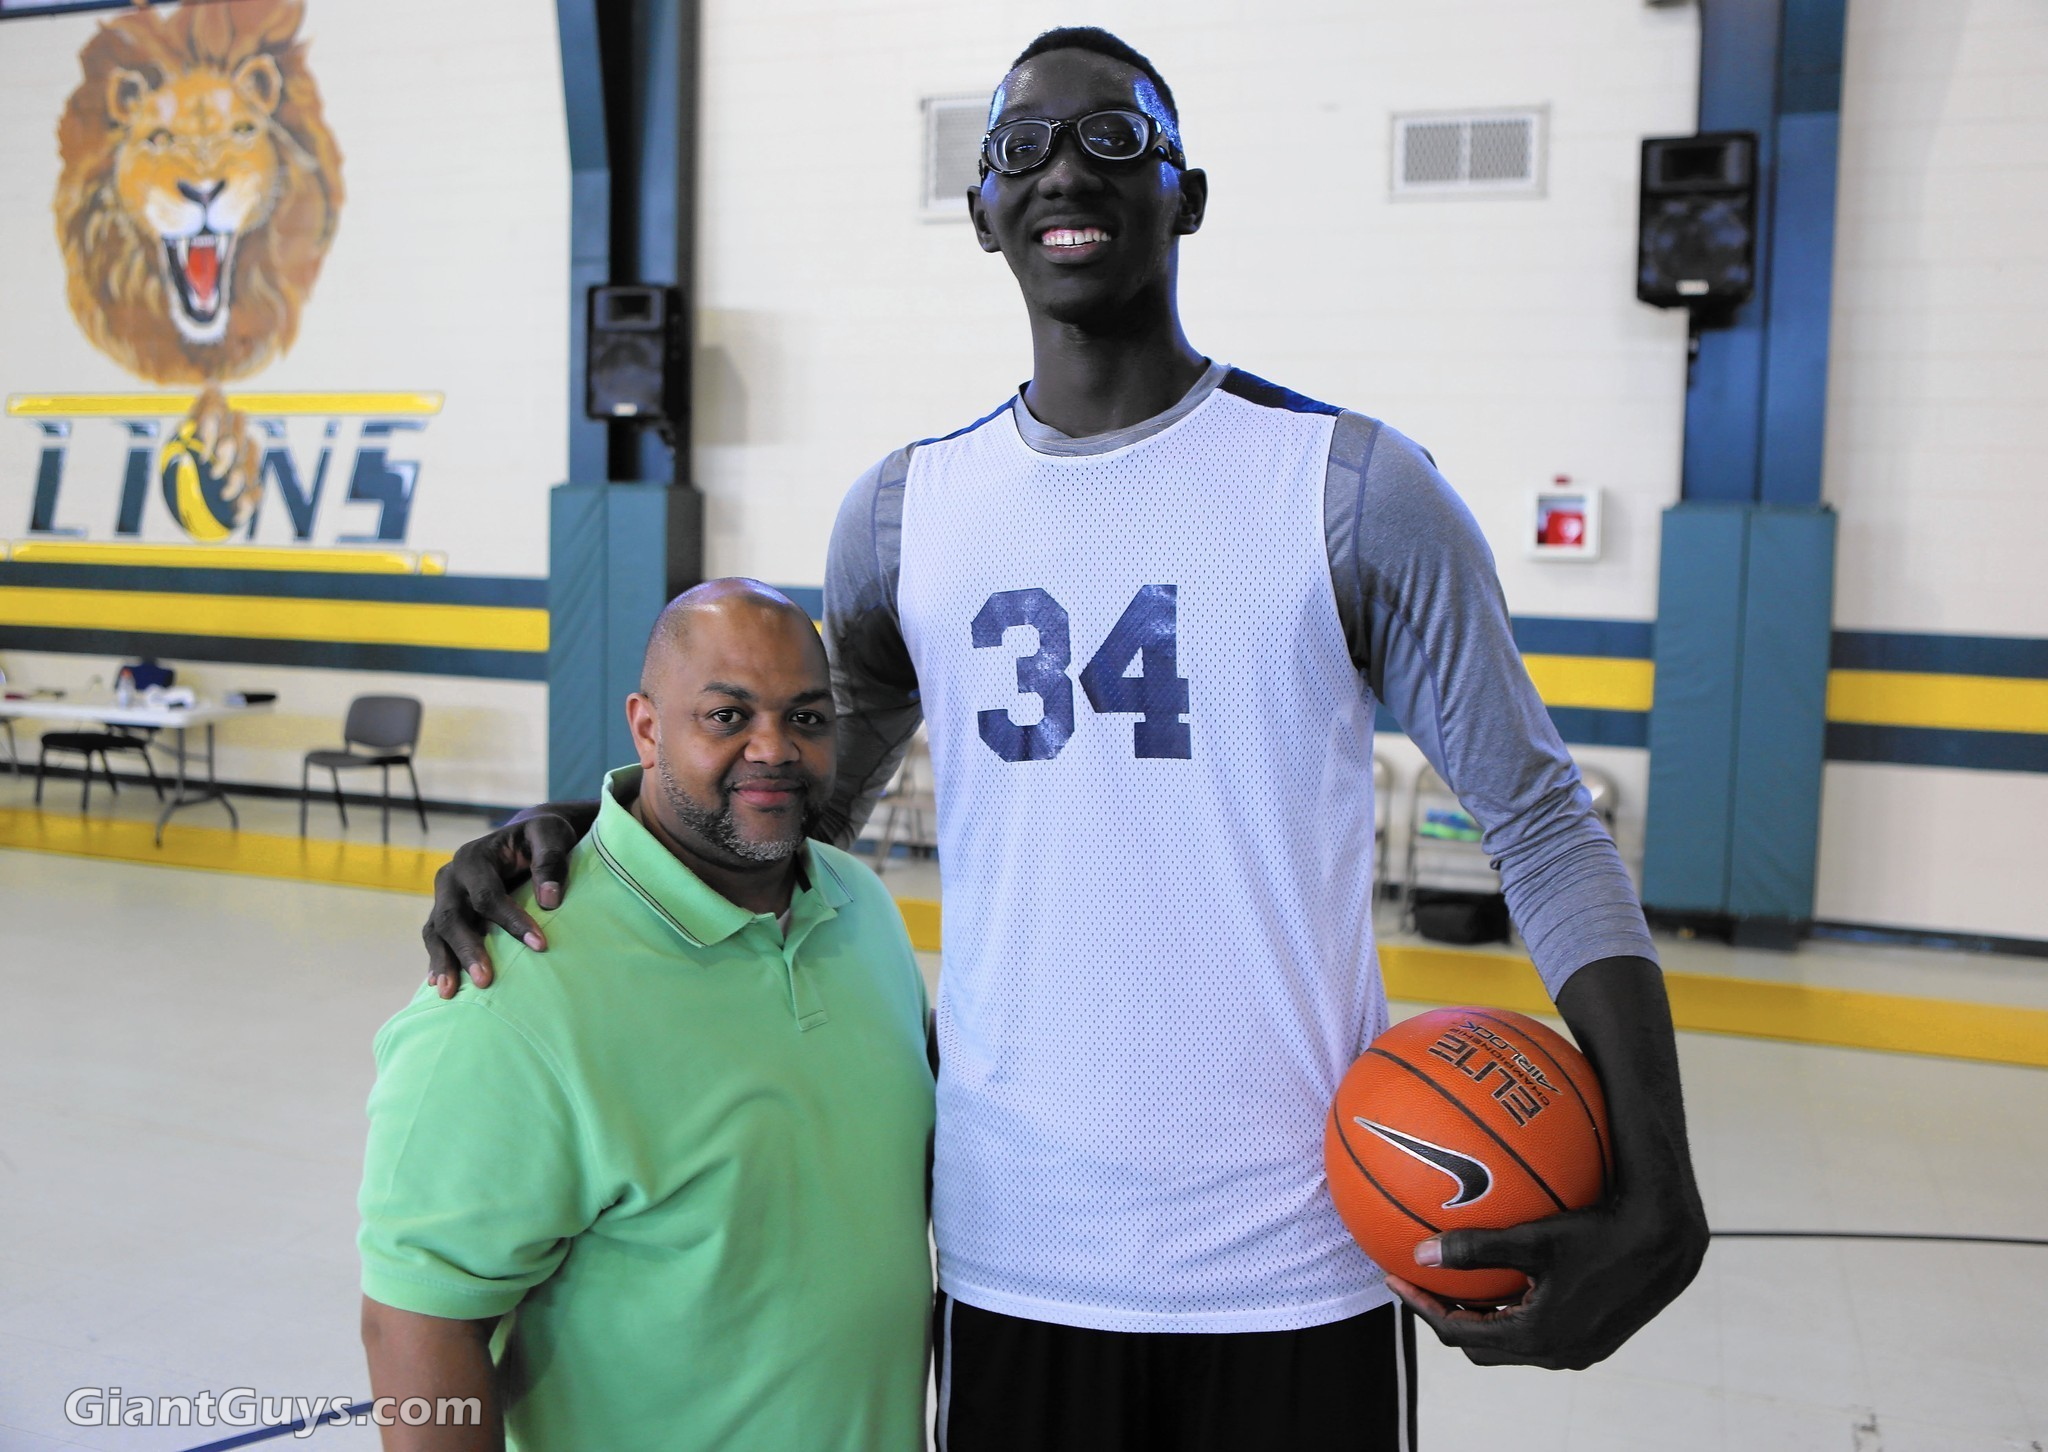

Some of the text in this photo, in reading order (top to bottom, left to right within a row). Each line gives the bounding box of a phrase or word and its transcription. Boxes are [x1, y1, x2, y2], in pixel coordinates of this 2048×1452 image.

[28, 418, 429, 545] LIONS
[970, 584, 1192, 763] 34
[1427, 1032, 1544, 1128] ELITE
[1449, 1027, 1550, 1107] CHAMPIONSHIP
